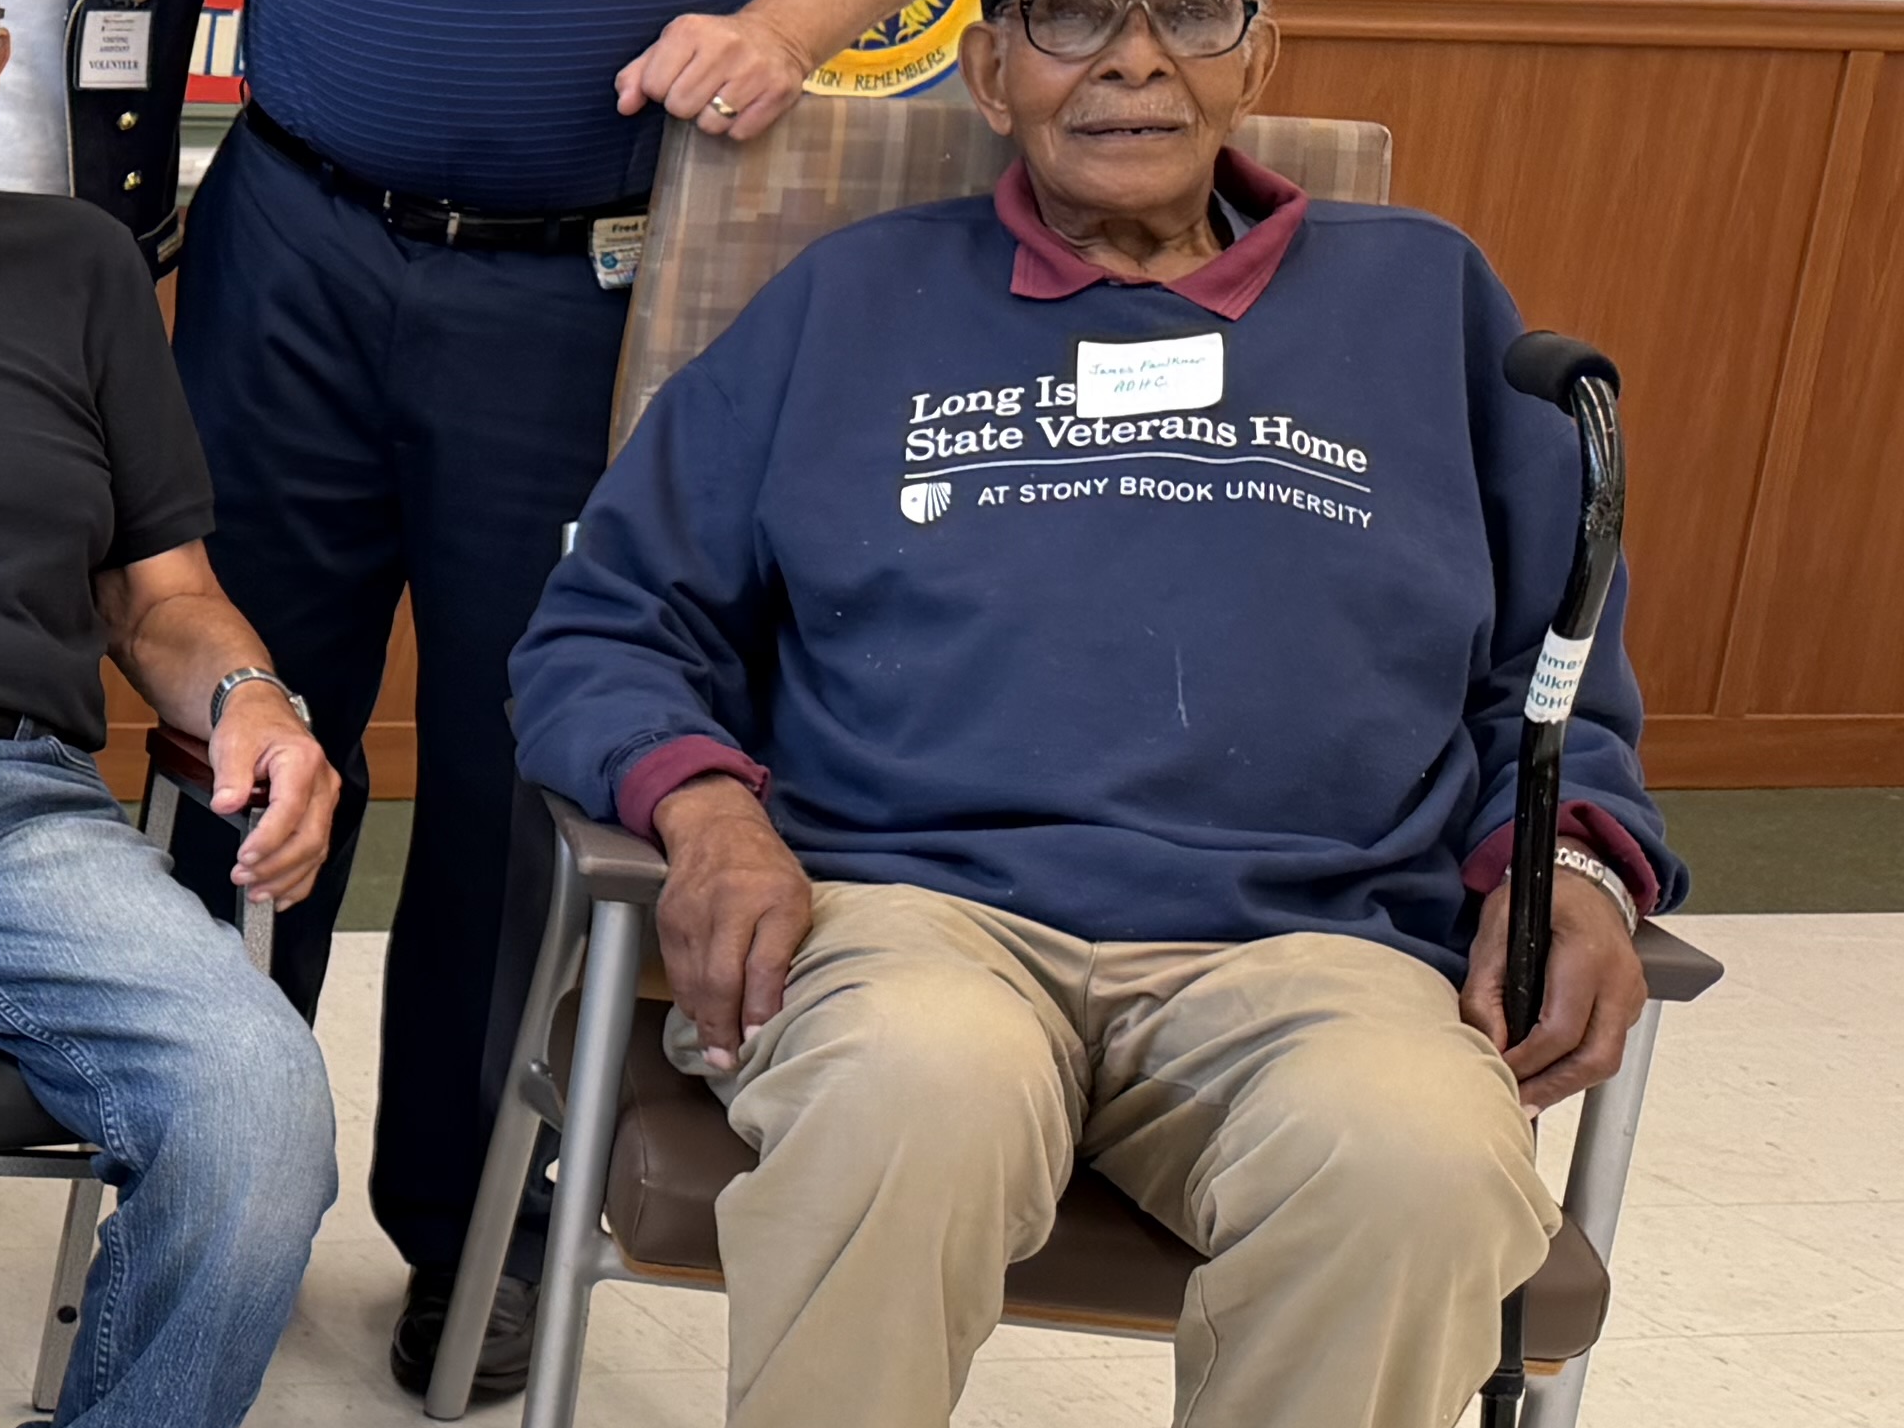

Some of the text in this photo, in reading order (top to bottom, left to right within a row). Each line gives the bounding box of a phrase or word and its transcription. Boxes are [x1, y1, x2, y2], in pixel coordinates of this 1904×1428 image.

[854, 46, 946, 92] REMEMBERS
[909, 384, 1025, 425] Long
[904, 415, 1369, 474] State Veterans Home
[977, 476, 1372, 529] AT STONY BROOK UNIVERSITY
